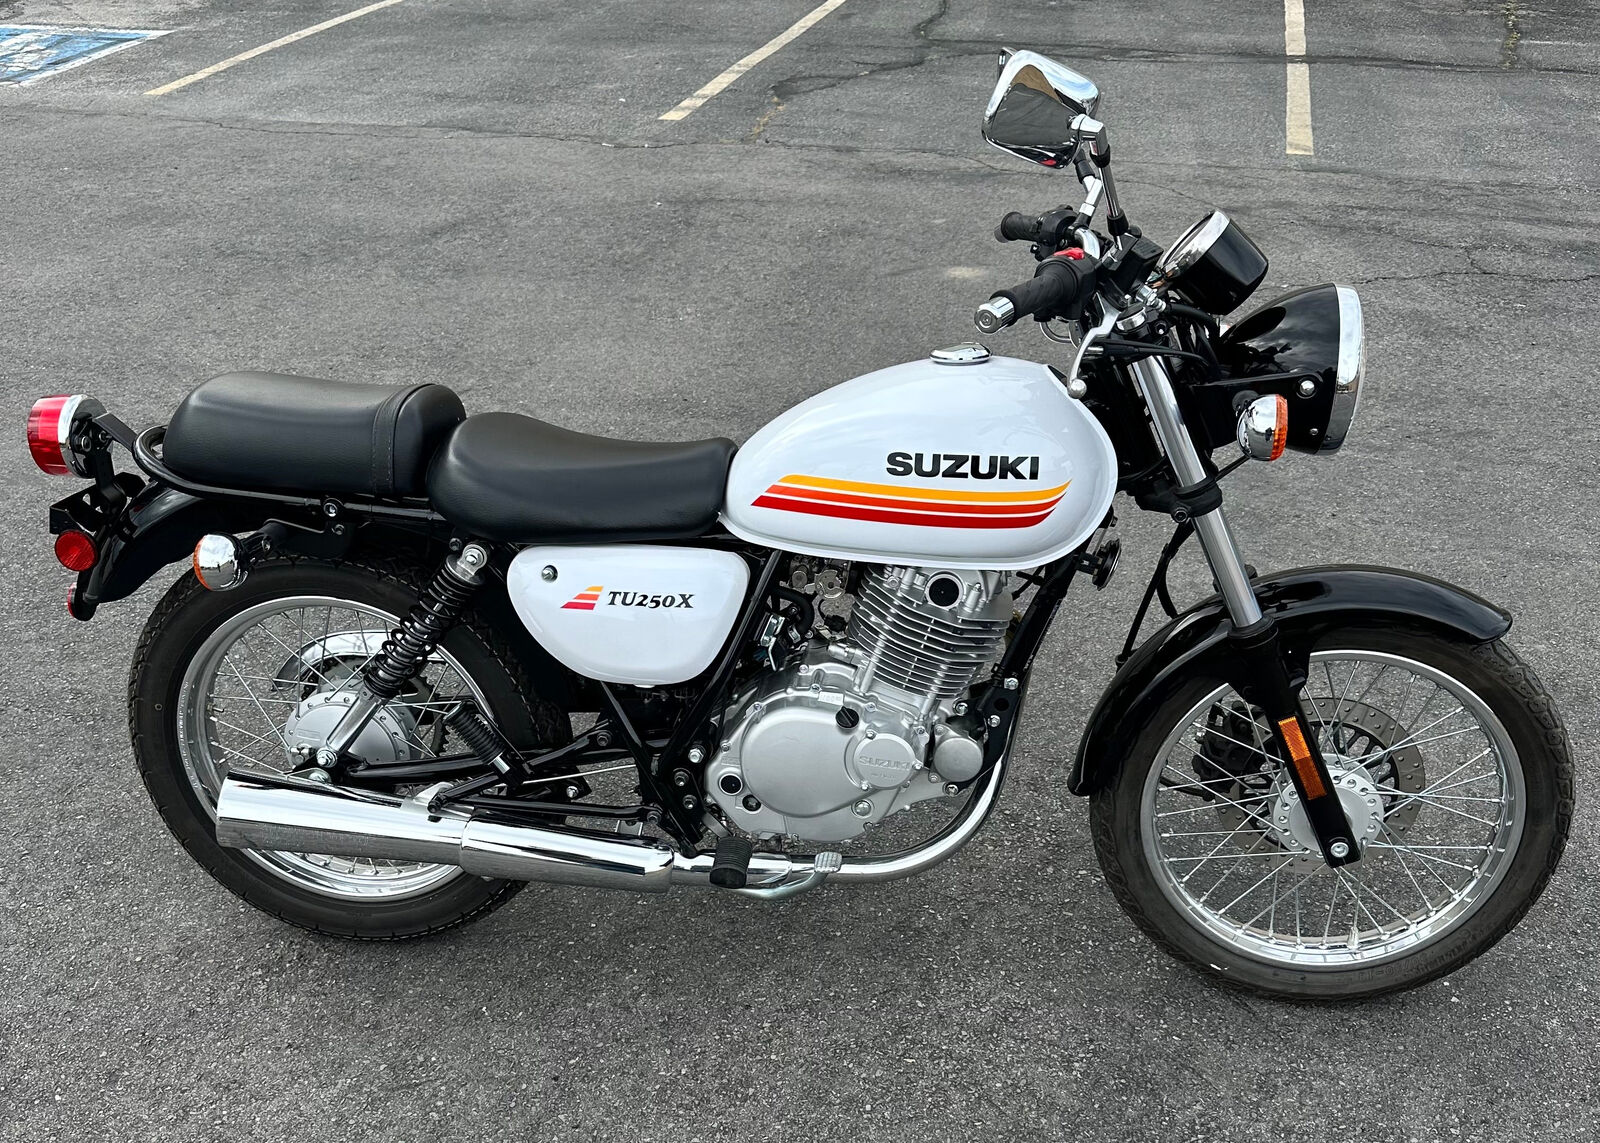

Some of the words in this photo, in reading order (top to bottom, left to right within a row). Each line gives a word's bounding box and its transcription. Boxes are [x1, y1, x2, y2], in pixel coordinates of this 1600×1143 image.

[886, 452, 1040, 481] SUZUKI
[607, 591, 695, 609] TU250X
[859, 755, 911, 771] SUZUKI
